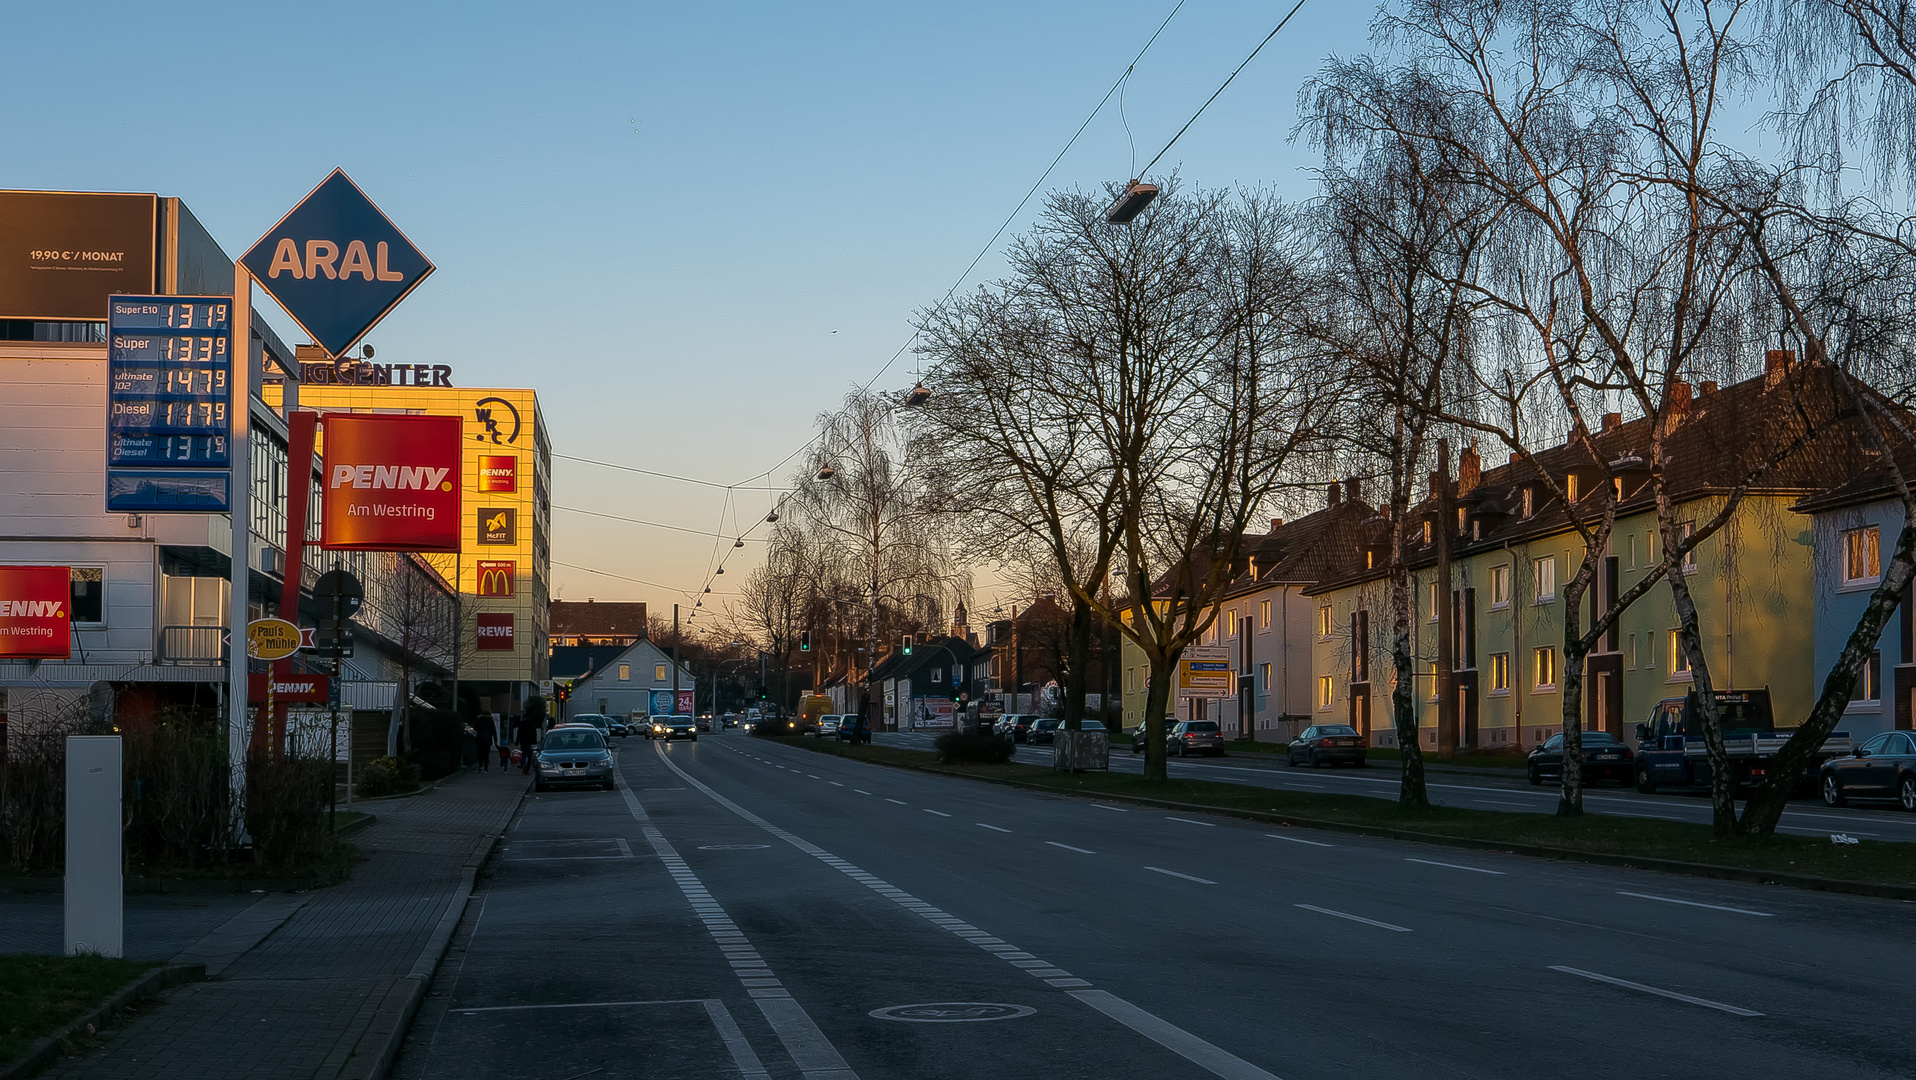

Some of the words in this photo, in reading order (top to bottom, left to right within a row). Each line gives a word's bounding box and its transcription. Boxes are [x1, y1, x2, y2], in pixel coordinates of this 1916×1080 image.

[29, 249, 60, 261] 19,90
[82, 251, 124, 262] MONAT
[268, 238, 404, 282] ARAL
[115, 305, 142, 316] Super
[142, 306, 158, 315] E10
[114, 337, 150, 351] Super
[115, 372, 153, 381] ultimate
[334, 357, 454, 388] CENTER
[114, 381, 131, 391] 102
[114, 402, 150, 415] Diesel
[114, 438, 152, 447] ultimate
[114, 447, 147, 457] Diesel
[347, 503, 370, 517] Am
[373, 504, 435, 521] Westring
[10, 625, 54, 638] Westring
[478, 626, 513, 638] REWE
[265, 636, 297, 650] Mühle
